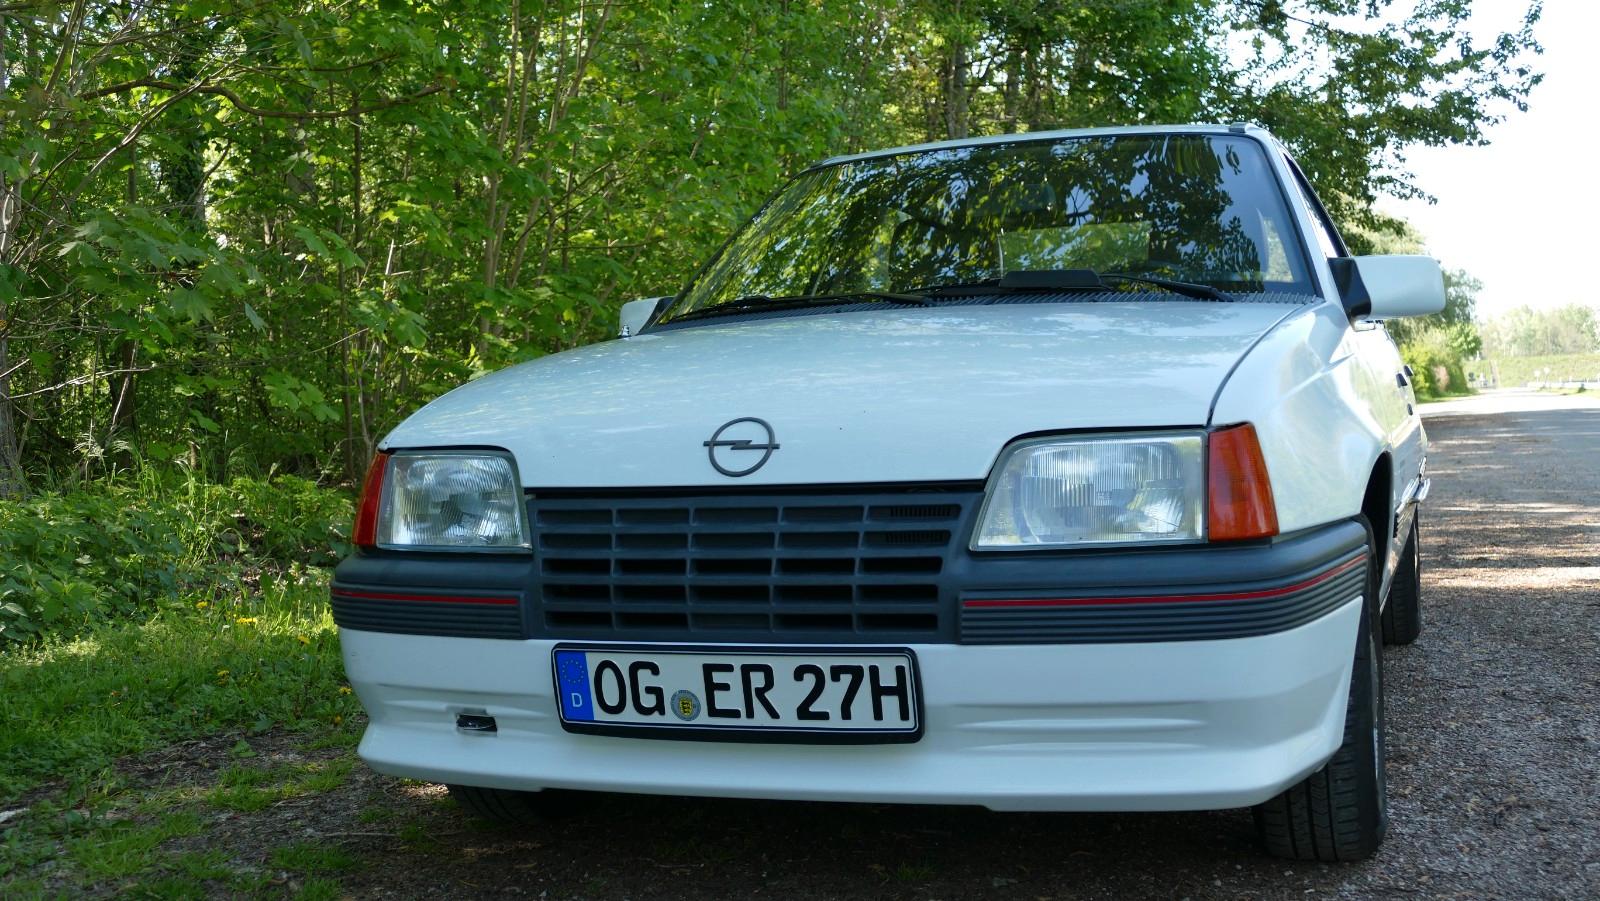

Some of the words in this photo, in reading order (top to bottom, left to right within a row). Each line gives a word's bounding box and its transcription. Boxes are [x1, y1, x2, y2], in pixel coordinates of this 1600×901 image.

[571, 692, 583, 708] D
[593, 660, 666, 716] OG
[702, 663, 780, 719] ER
[793, 664, 910, 721] 27H
